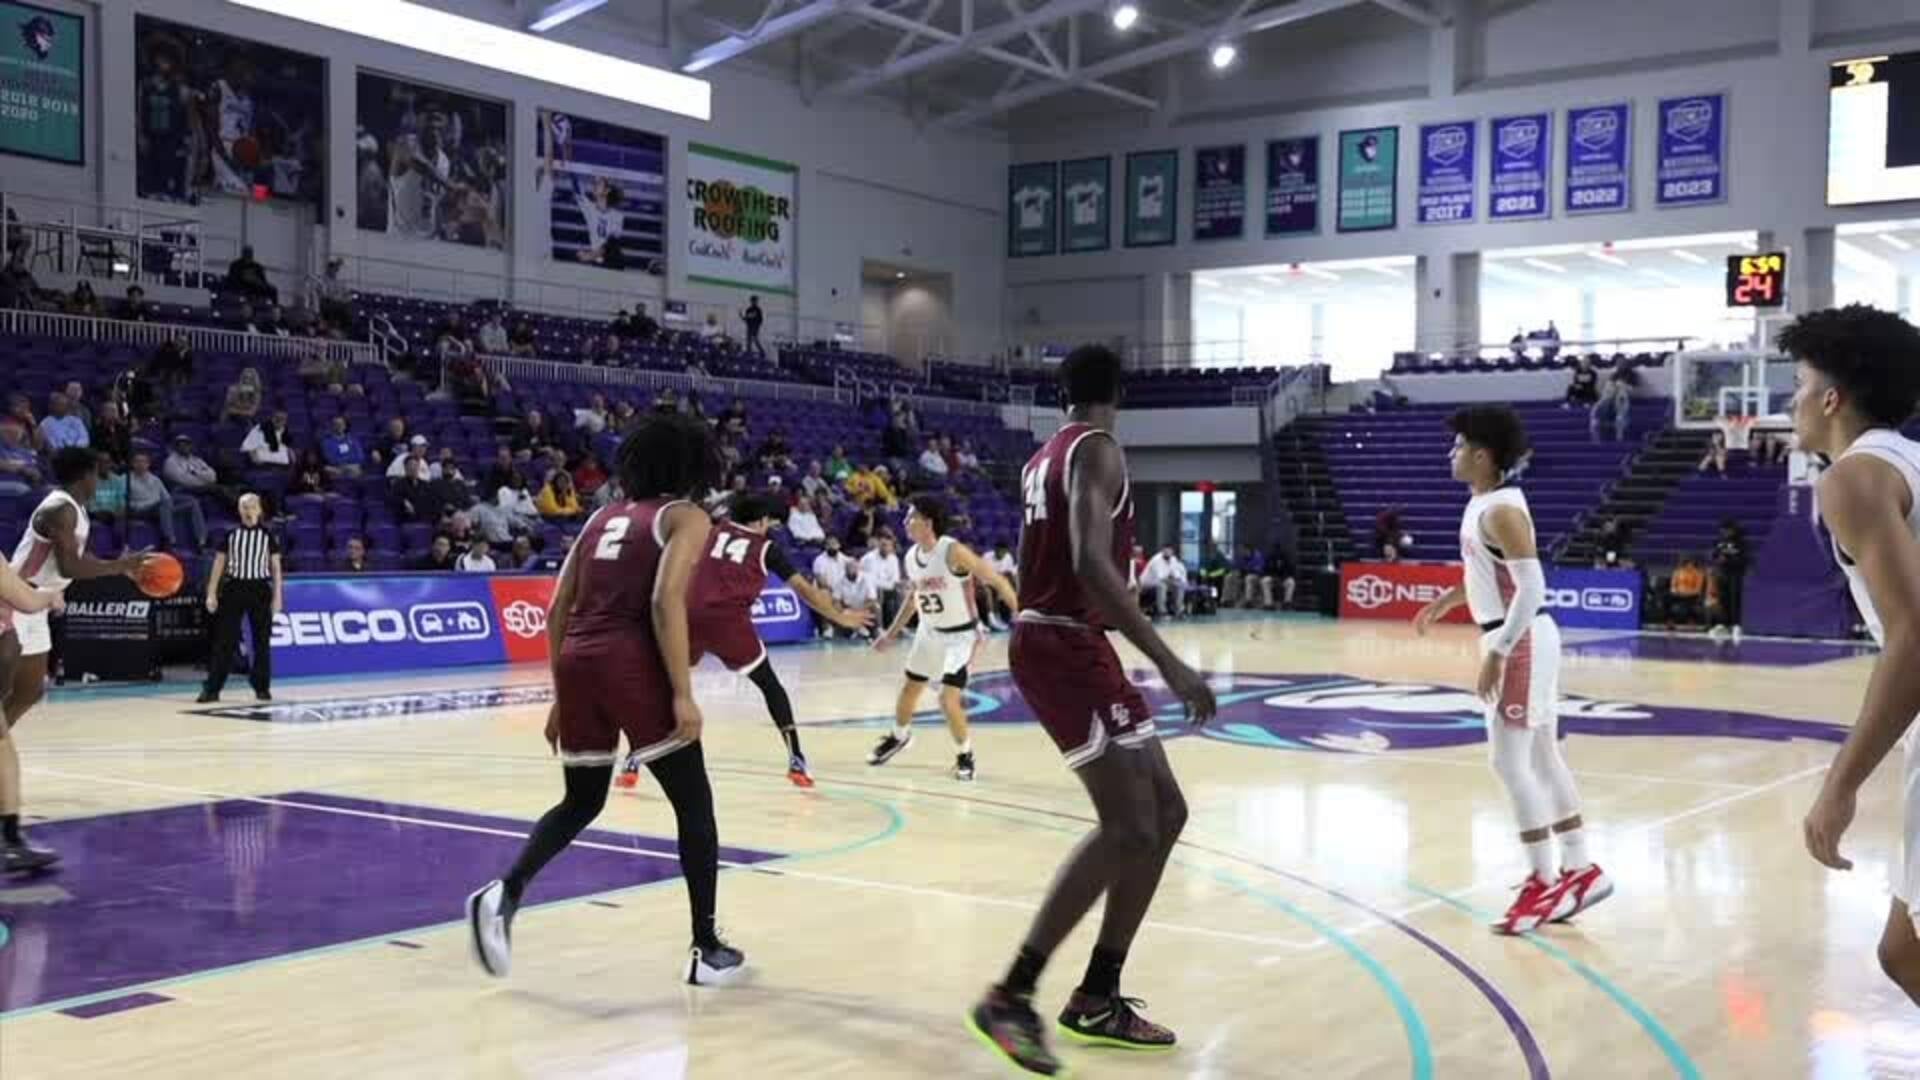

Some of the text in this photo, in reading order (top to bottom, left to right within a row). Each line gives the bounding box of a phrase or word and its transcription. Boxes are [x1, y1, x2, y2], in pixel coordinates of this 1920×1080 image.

[1571, 187, 1618, 206] 2022
[1663, 179, 1713, 198] 2023
[1425, 204, 1464, 221] 2017
[1496, 195, 1536, 213] 2021
[694, 207, 780, 243] ROOFING
[1735, 275, 1773, 303] 24
[594, 516, 631, 560] 2
[710, 532, 750, 563] 14
[1395, 585, 1455, 601] NEX
[918, 593, 944, 614] 23
[270, 609, 407, 646] GEICO
[1505, 704, 1524, 720] C
